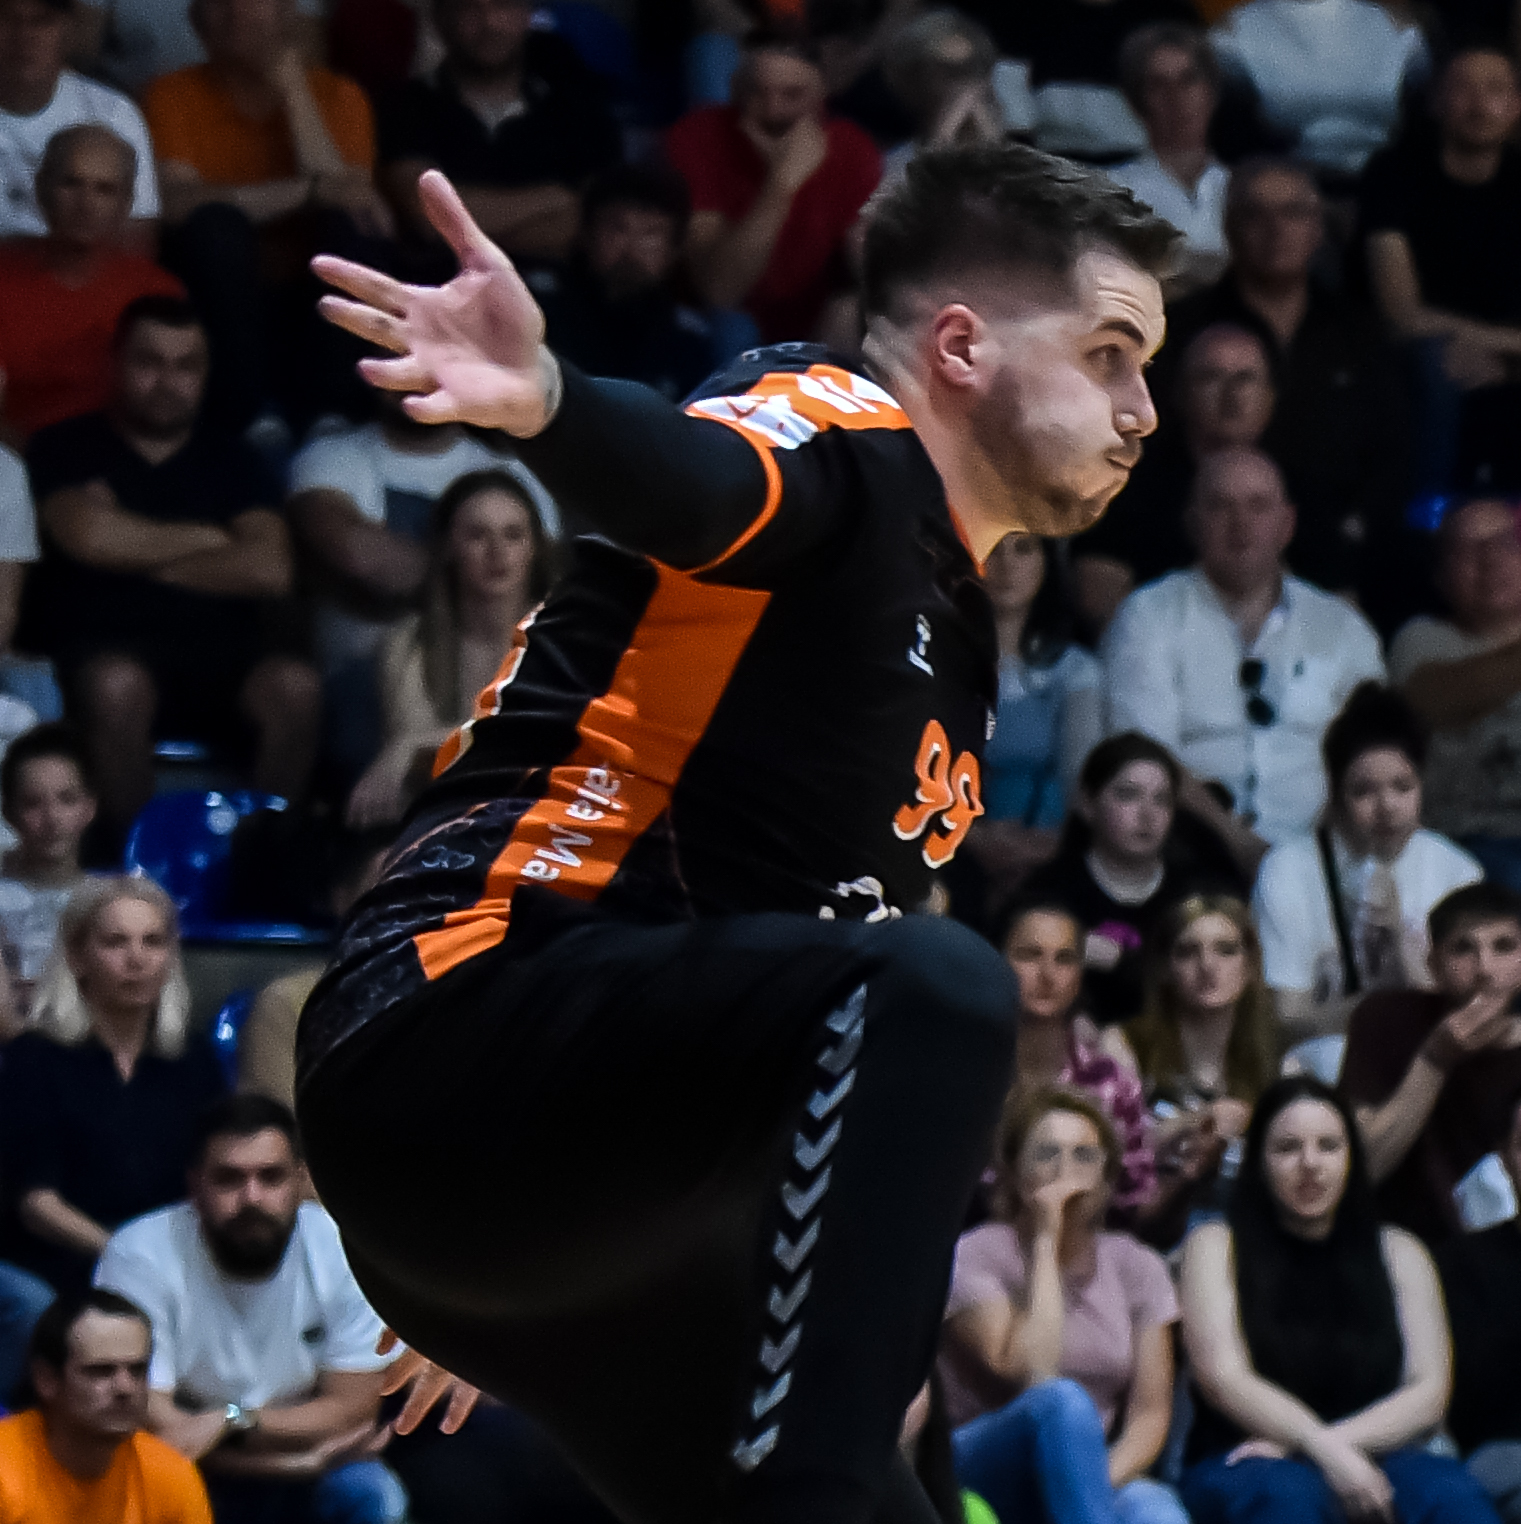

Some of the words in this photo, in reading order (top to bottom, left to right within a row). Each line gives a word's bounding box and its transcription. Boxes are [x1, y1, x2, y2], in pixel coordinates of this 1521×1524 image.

[566, 768, 622, 821] aia
[892, 719, 985, 869] 99
[520, 823, 594, 882] Ma
